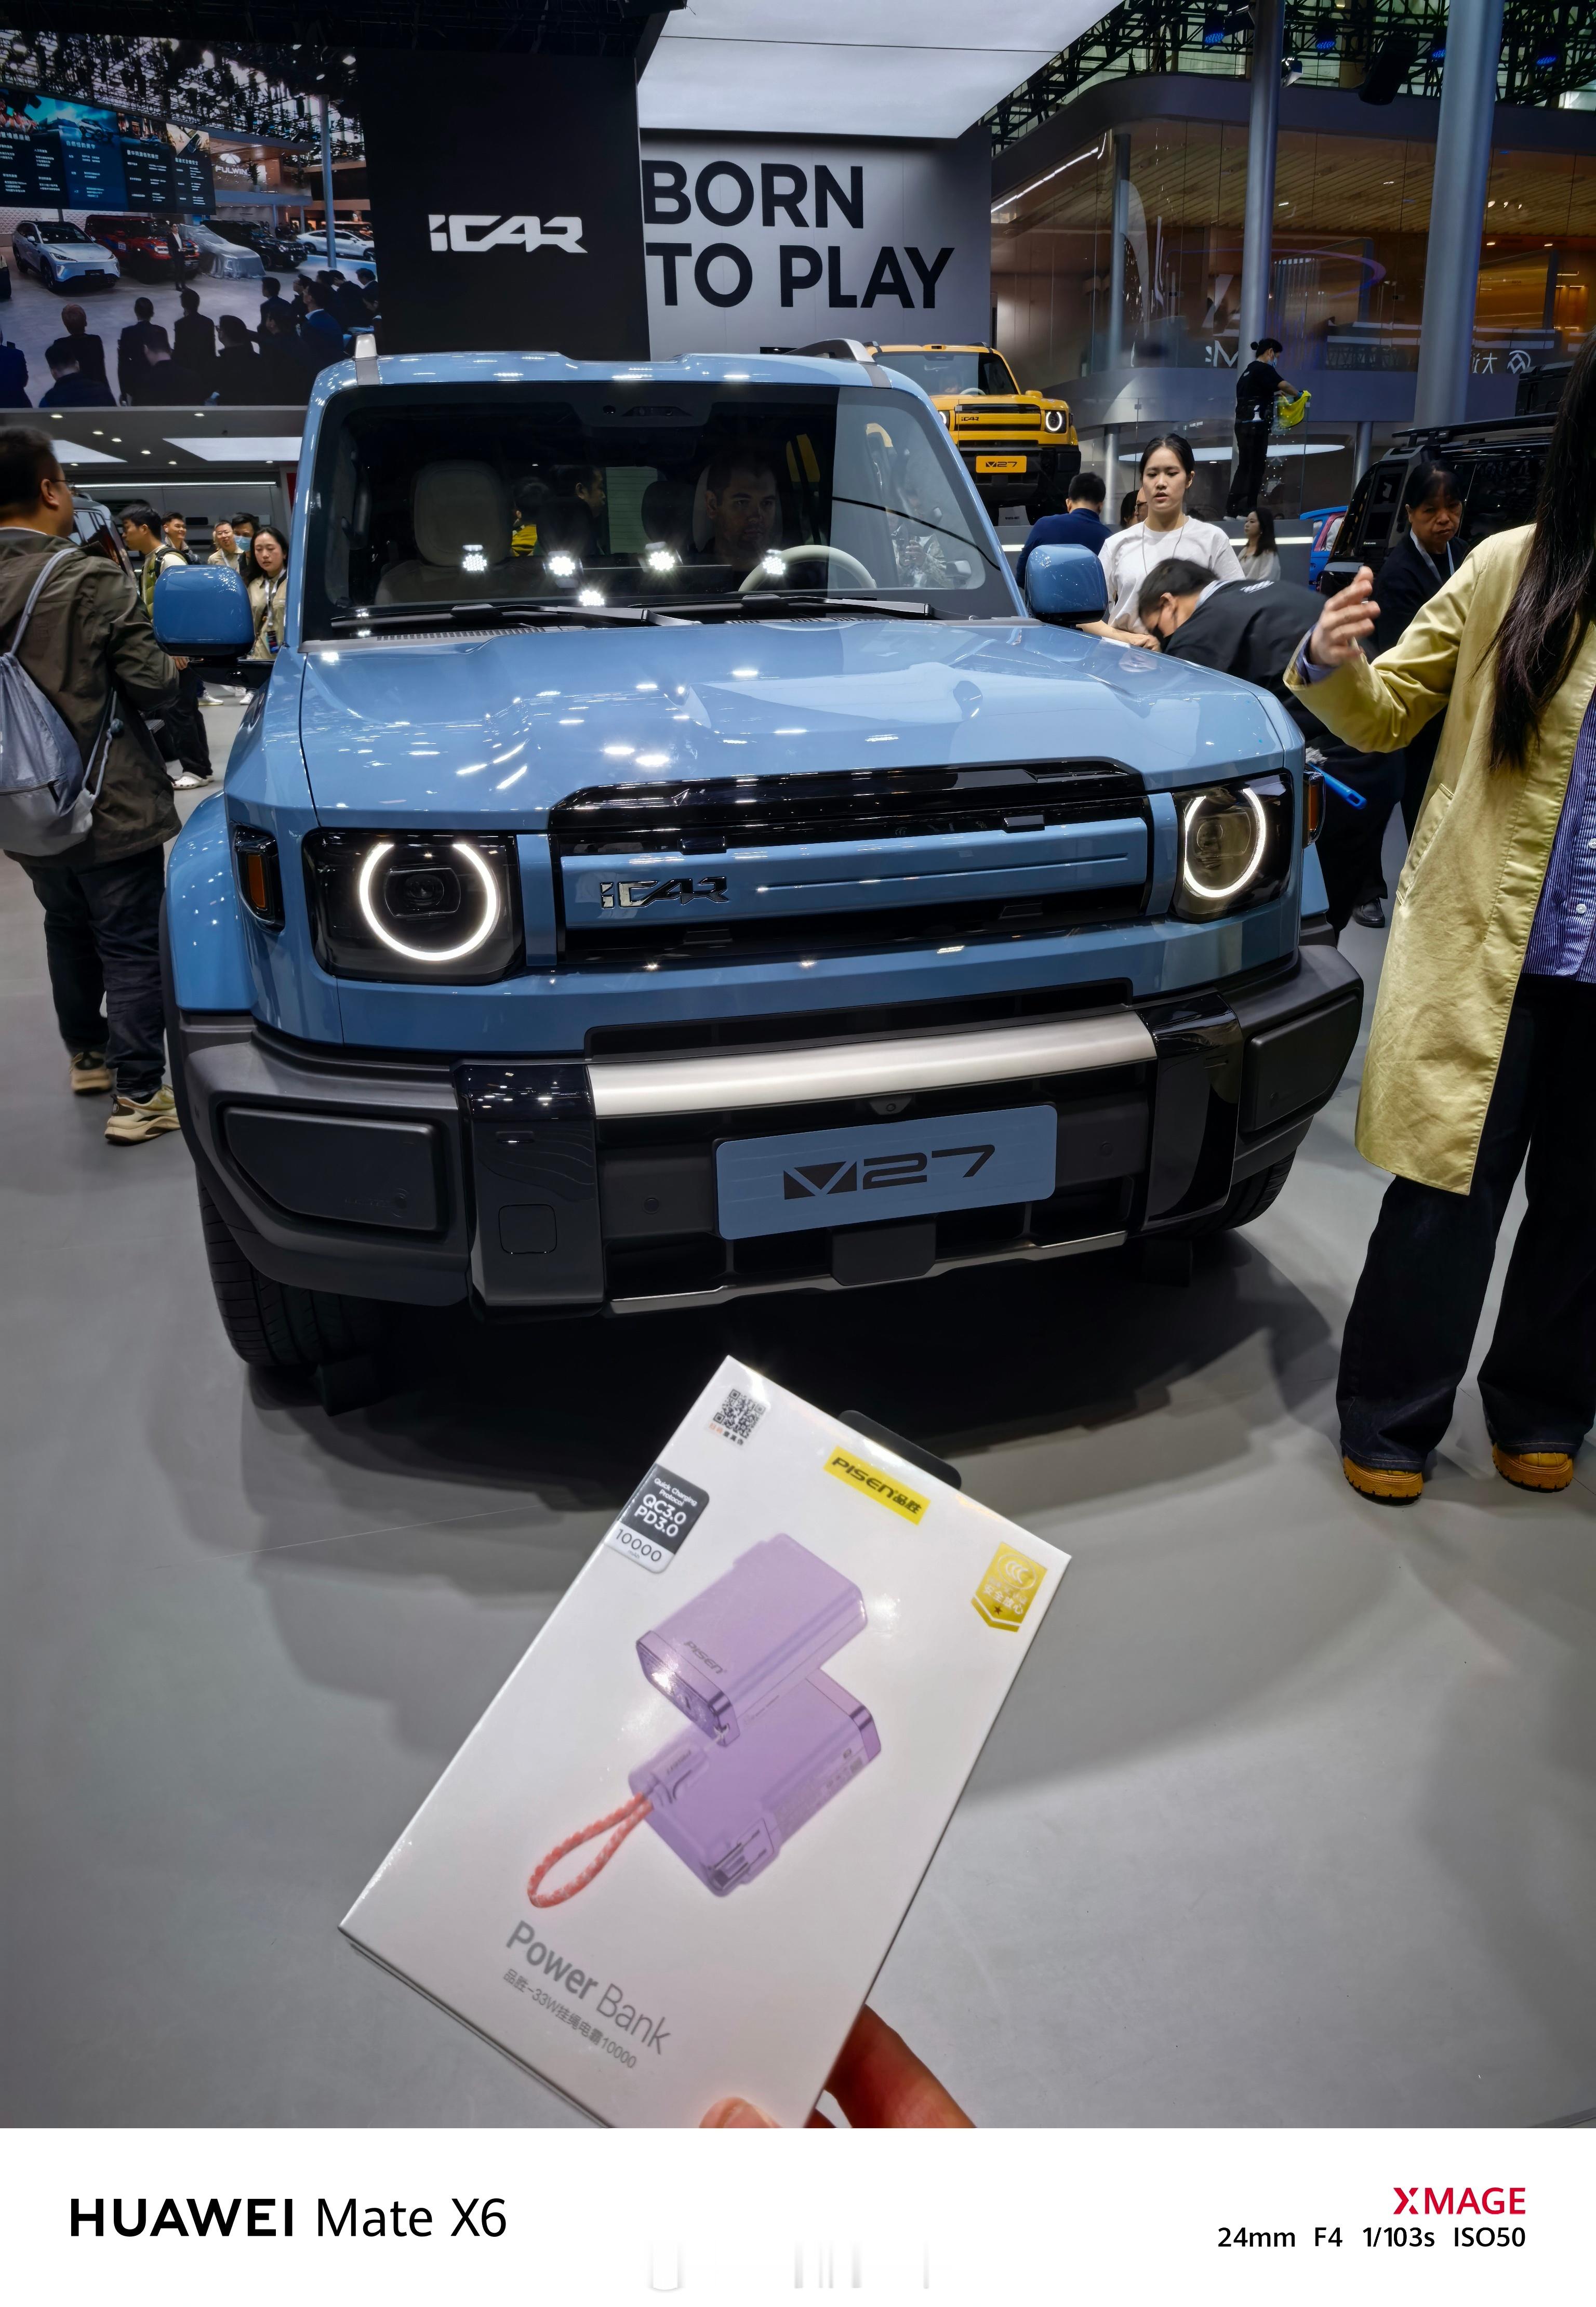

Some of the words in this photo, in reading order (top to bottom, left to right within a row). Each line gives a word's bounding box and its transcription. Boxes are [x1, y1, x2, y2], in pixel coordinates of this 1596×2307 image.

[643, 160, 863, 229] BORN
[646, 243, 752, 307] TO
[780, 245, 955, 309] PLAY
[783, 1145, 995, 1200] V27
[654, 1478, 671, 1491] Quick
[672, 1488, 698, 1507] Charging
[659, 1489, 685, 1507] Protocol
[634, 1505, 679, 1537] PD3.0
[643, 1494, 687, 1524] QC3.0
[616, 1529, 661, 1561] 10000
[628, 1550, 640, 1559] mAh
[506, 1920, 598, 2000] Power
[596, 1983, 671, 2054] Bank
